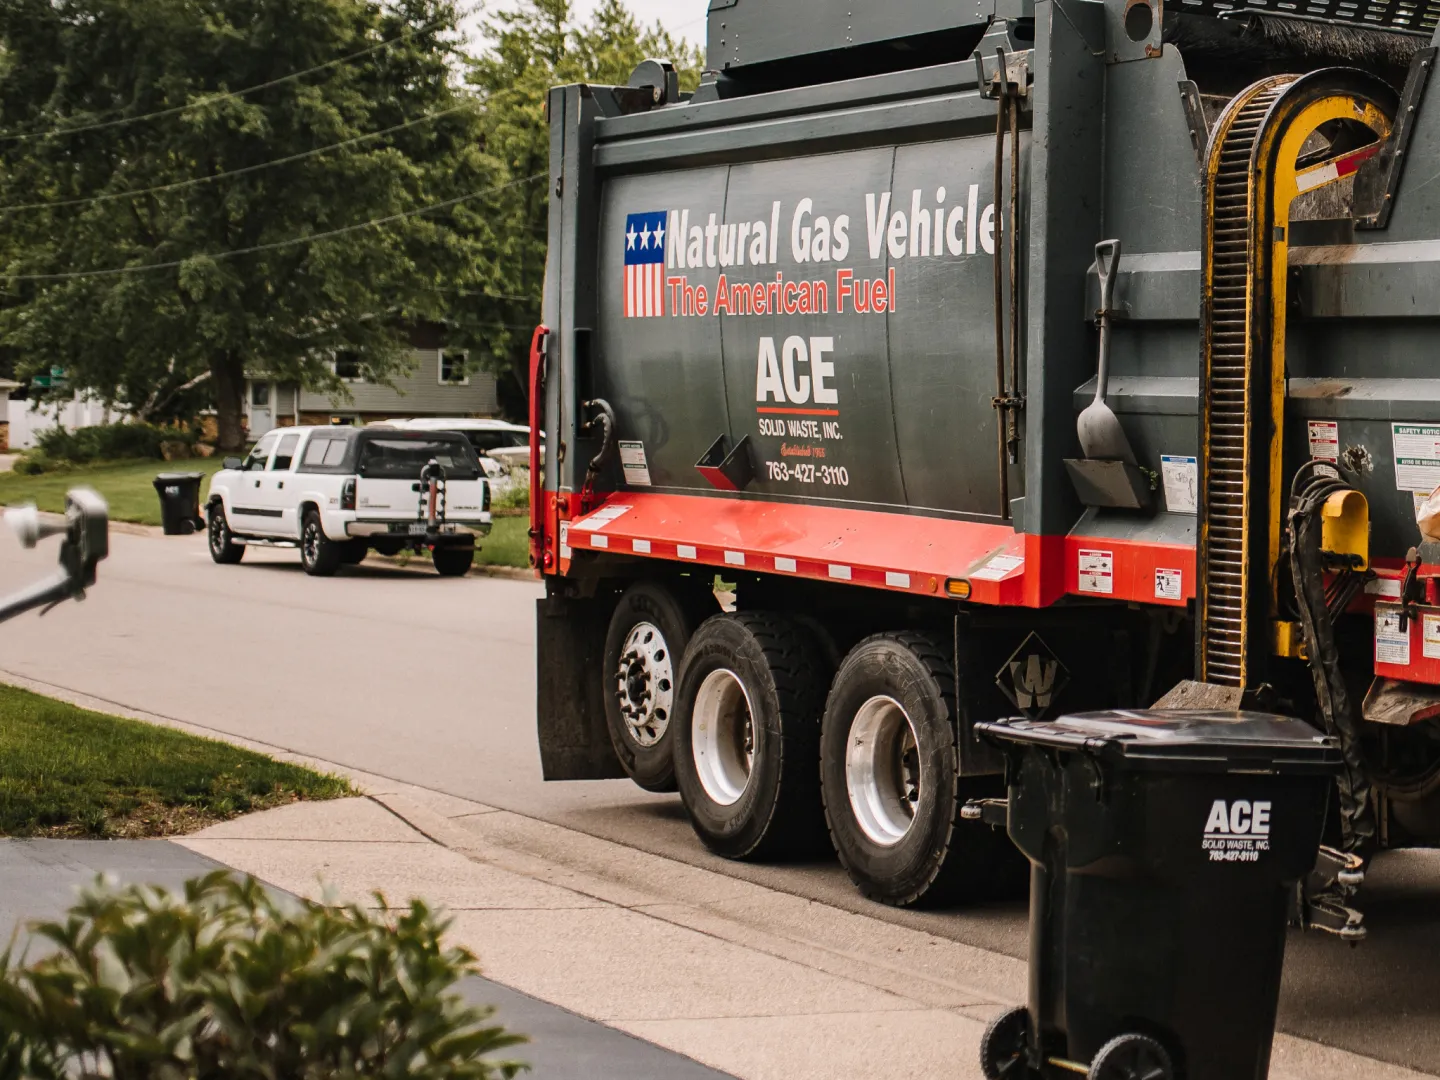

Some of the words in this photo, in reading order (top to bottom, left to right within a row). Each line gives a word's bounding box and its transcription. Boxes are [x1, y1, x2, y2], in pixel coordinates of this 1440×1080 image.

[667, 201, 781, 269] Natural
[791, 197, 850, 264] Gas
[865, 184, 1003, 259] Vehicle
[667, 276, 708, 317] The
[713, 271, 828, 316] American
[836, 267, 896, 313] Fuel
[756, 335, 839, 404] ACE
[759, 418, 786, 437] SOLID
[787, 420, 822, 442] WASTE,
[823, 422, 843, 440] INC.
[1399, 427, 1420, 435] SAFETY
[765, 461, 849, 486] 763-427-3110
[1204, 800, 1271, 834] ACE
[1202, 840, 1225, 850] SOLID
[1227, 840, 1254, 851] WASTE,
[1256, 841, 1270, 851] INC.
[1209, 850, 1259, 862] 763-427-3110
